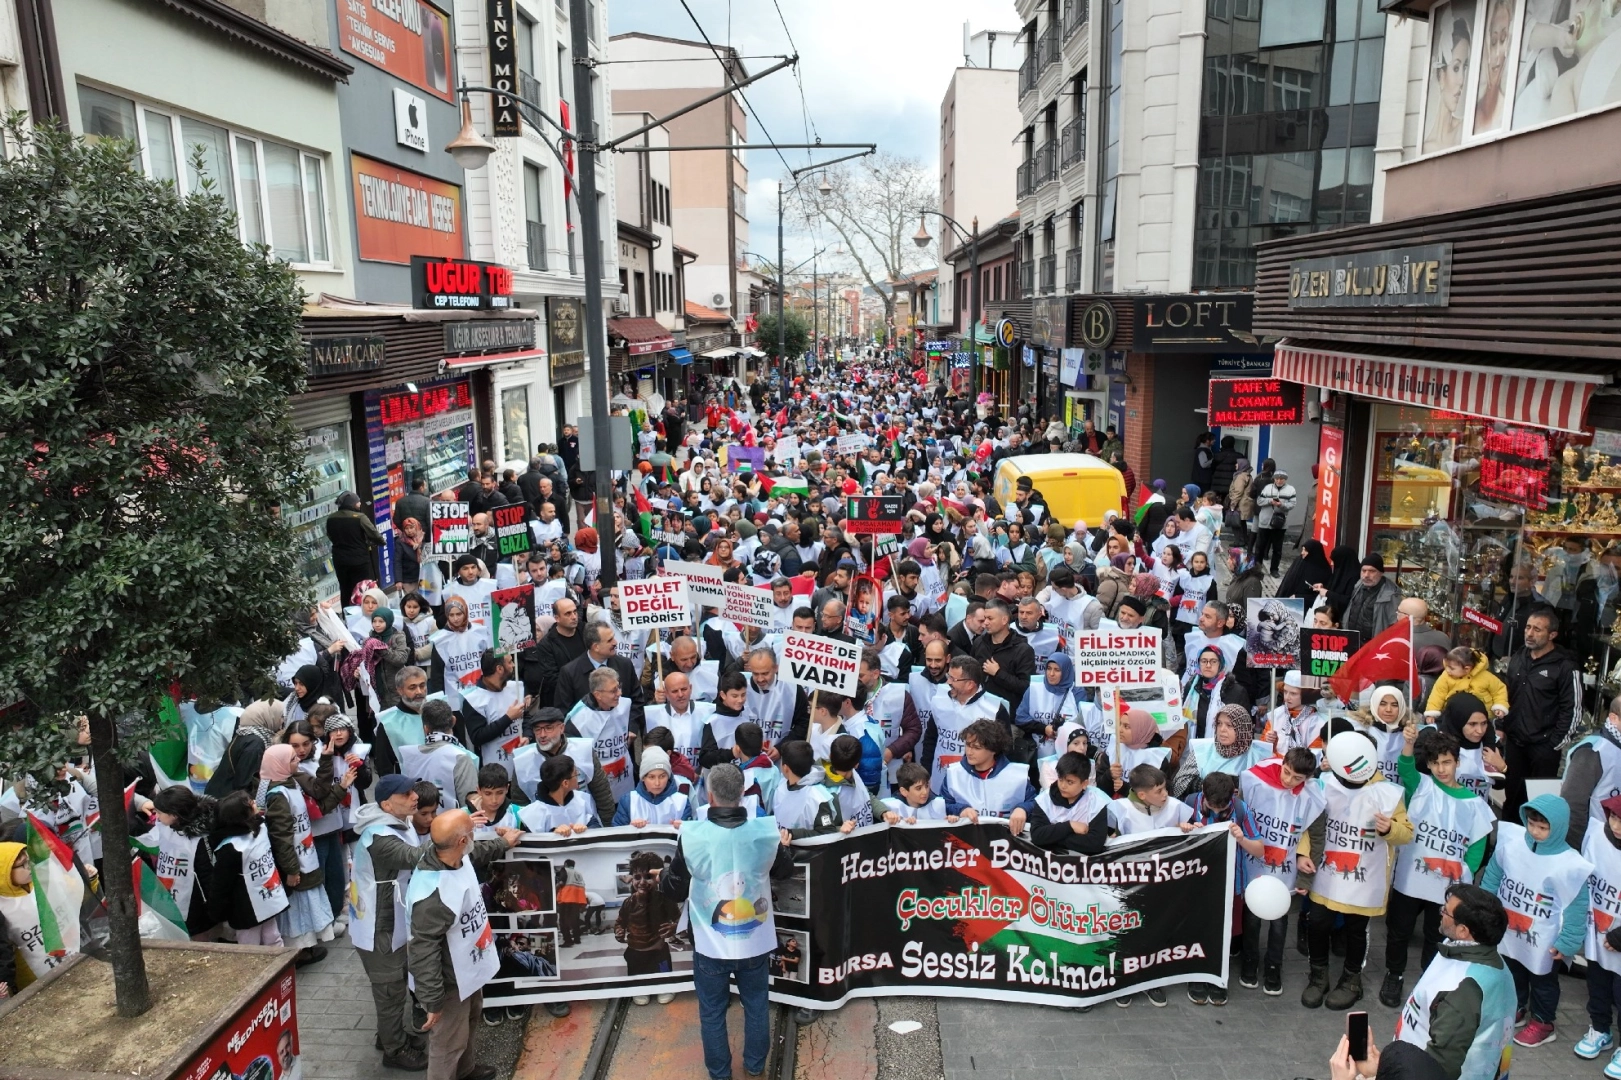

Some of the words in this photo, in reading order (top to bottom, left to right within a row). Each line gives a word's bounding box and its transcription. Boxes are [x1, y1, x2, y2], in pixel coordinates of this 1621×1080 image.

[351, 37, 386, 65] AKSESUAR
[373, 30, 396, 53] SERVİS
[494, 64, 513, 123] MODA
[404, 129, 425, 149] iPhone
[411, 181, 430, 229] DAİR
[426, 256, 481, 294] UĞUR
[1291, 266, 1330, 299] ÖZEN
[1333, 256, 1440, 298] BİLLURİYE
[434, 296, 448, 307] CEP
[449, 296, 480, 307] TELEFONU
[1090, 310, 1105, 339] B
[1146, 301, 1237, 328] LOFT
[452, 323, 470, 349] UĞUR
[471, 324, 500, 347] AKSESUAR
[314, 345, 352, 366] NAZAR
[354, 343, 385, 367] ÇARŞI
[1218, 358, 1241, 367] TÜRKİYE
[1233, 382, 1262, 393] KAFE
[1265, 382, 1281, 392] VE
[1398, 375, 1450, 400] billuriye
[1229, 396, 1284, 407] LOKANTA
[1215, 408, 1296, 422] MALZEMELERİ
[1319, 446, 1337, 547] GÜRAL
[432, 503, 468, 519] STOP
[495, 505, 525, 526] STOP
[498, 523, 527, 538] BOMBING
[433, 541, 468, 553] NOW
[500, 535, 530, 555] GAZA
[876, 541, 899, 557] NOW
[623, 581, 682, 597] DEVLET
[724, 585, 772, 604] İYONİSTLER
[626, 594, 683, 613] DEĞİL,
[727, 599, 753, 608] KADIN
[754, 602, 765, 610] VE
[628, 611, 685, 625] TERÖRİST
[722, 611, 769, 627] ÖLDÜRÜYOR
[786, 636, 857, 660] GAZZE'DE
[1079, 633, 1157, 649] FİLİSTİN
[1311, 634, 1348, 650] STOP
[450, 659, 480, 672] FİLİST
[785, 648, 856, 673] SOYKIRIM
[1081, 658, 1126, 668] HİÇBİRİMİZ
[1127, 658, 1156, 666] ÖZGÜR
[1311, 650, 1348, 662] BOMBING
[791, 662, 846, 689] VAR!
[1081, 666, 1156, 684] DEĞİLİZ
[840, 842, 981, 884] Hastaneler
[989, 839, 1209, 885] Bombalanırken,
[896, 885, 1022, 931] Çocuklar
[1028, 885, 1143, 936] Ölürken
[818, 951, 894, 985] BURSA
[901, 941, 996, 980] Sessiz
[1006, 943, 1117, 990] Kalma!
[1123, 942, 1206, 975] BURSA
[227, 1031, 240, 1052] NE
